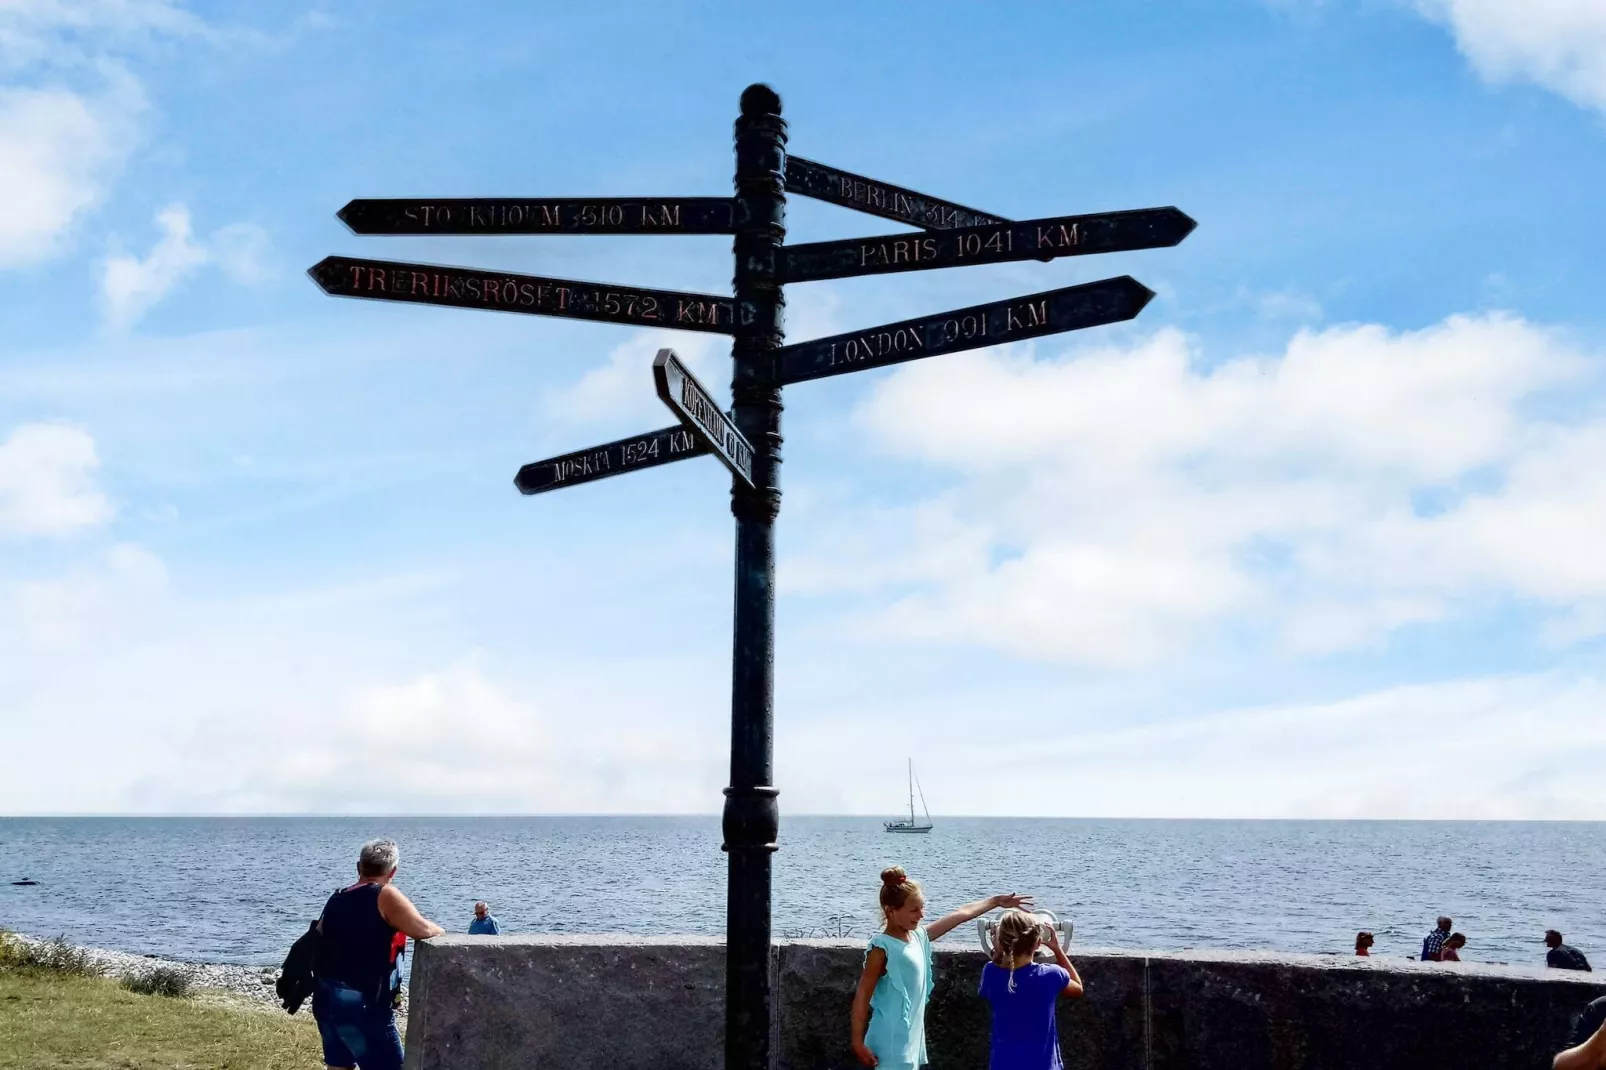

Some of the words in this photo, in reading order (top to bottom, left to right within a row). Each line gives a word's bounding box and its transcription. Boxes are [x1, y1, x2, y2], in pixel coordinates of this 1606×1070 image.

[403, 204, 562, 227] STOKHOM
[581, 204, 624, 227] 510
[640, 204, 681, 227] KM
[839, 176, 913, 216] BERLIN
[924, 201, 960, 229] 314
[859, 237, 938, 268] PARIS
[955, 228, 1013, 258] 1041
[1036, 221, 1080, 249] KM
[349, 264, 572, 311] TRERIKSRÖSET
[592, 291, 660, 321] 1572
[676, 299, 720, 326] KM
[828, 324, 925, 367] LONDON
[943, 315, 988, 345] 991
[1006, 299, 1049, 332] KM
[619, 437, 660, 467] 1524
[669, 430, 695, 454] KM
